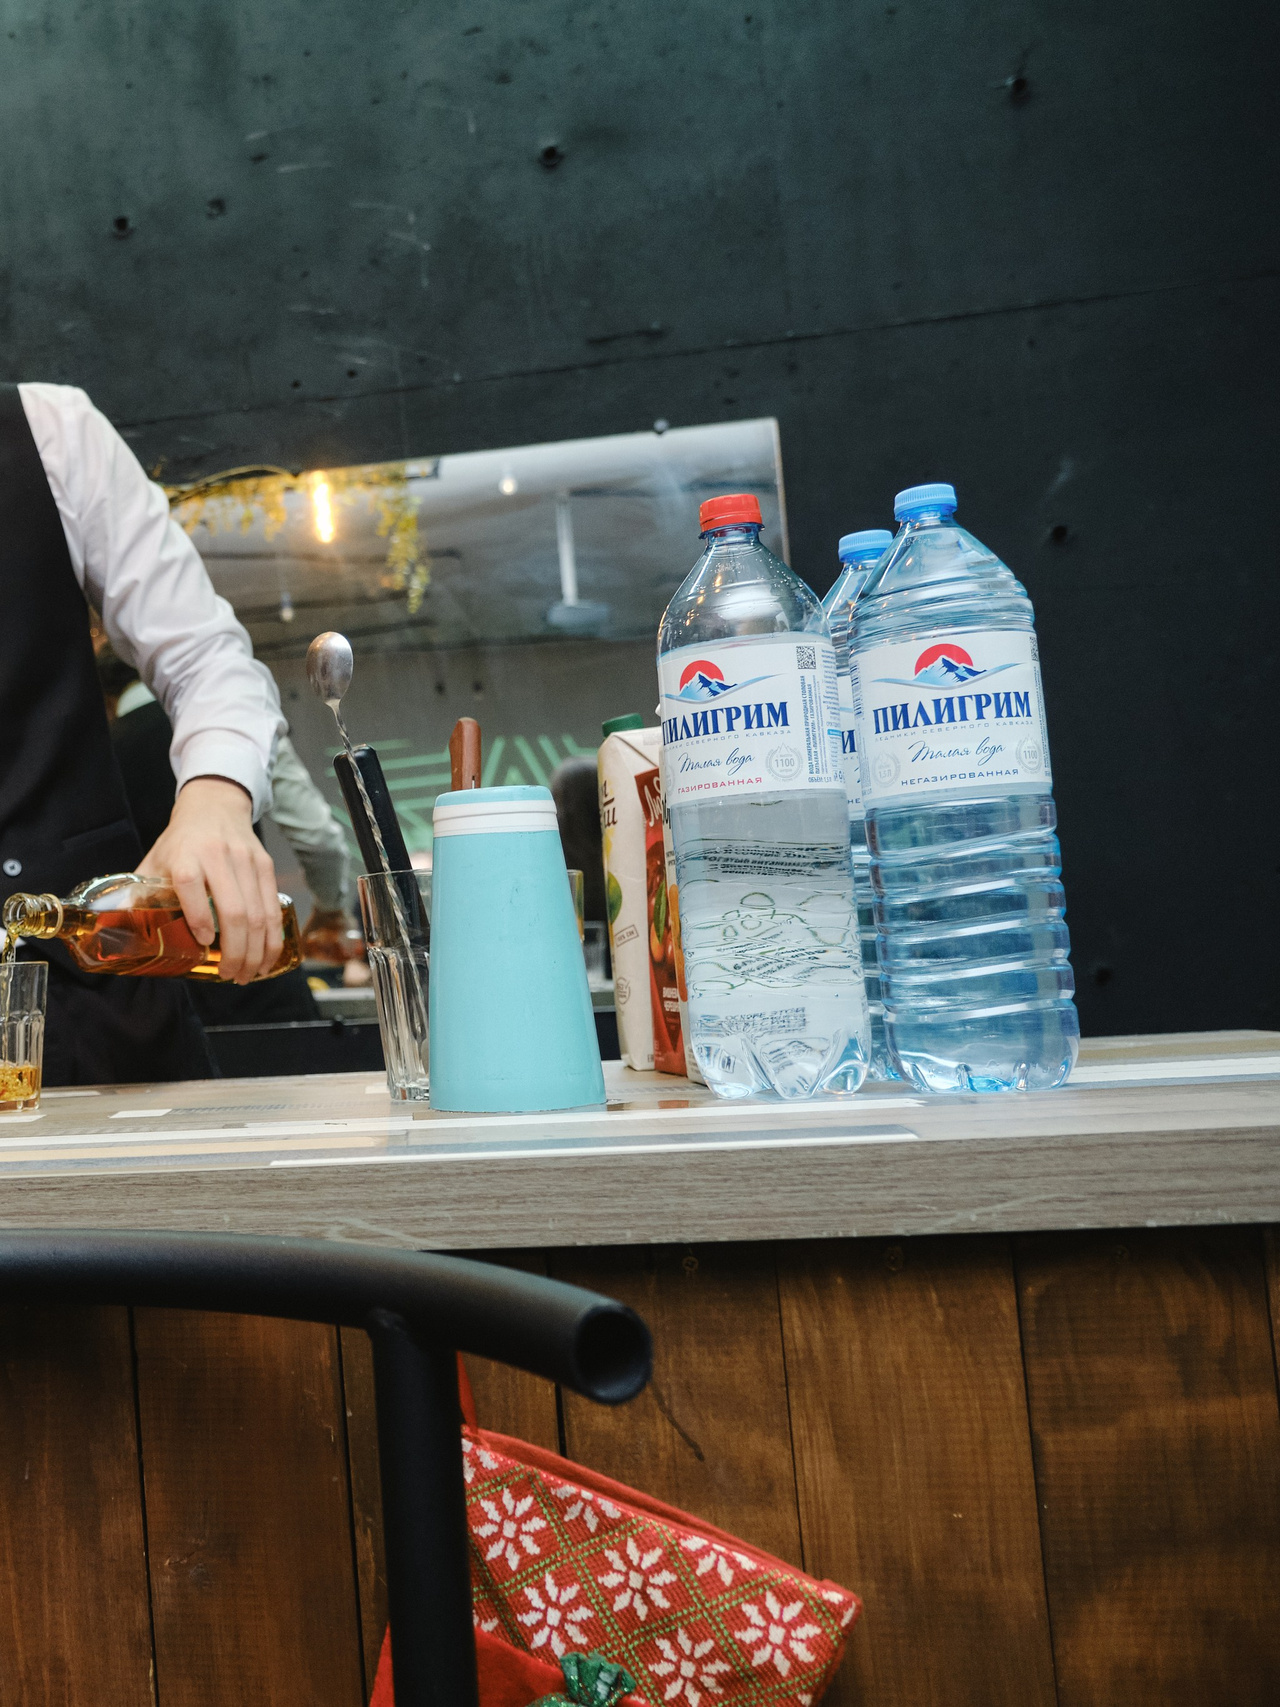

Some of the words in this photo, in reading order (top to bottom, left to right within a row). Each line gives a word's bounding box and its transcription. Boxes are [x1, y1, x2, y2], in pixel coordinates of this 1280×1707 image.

[872, 691, 1032, 735] ПИЛИГРИМ
[922, 722, 990, 735] СЕВЕРНОГО
[685, 733, 740, 747] СЕВЕРНОГО
[745, 729, 792, 738] КАВКАЗА
[774, 757, 796, 768] 1100
[677, 776, 763, 795] ГАЗИРОВАННАЯ
[900, 768, 1019, 786] НЕГАЗИРОВАННАЯ
